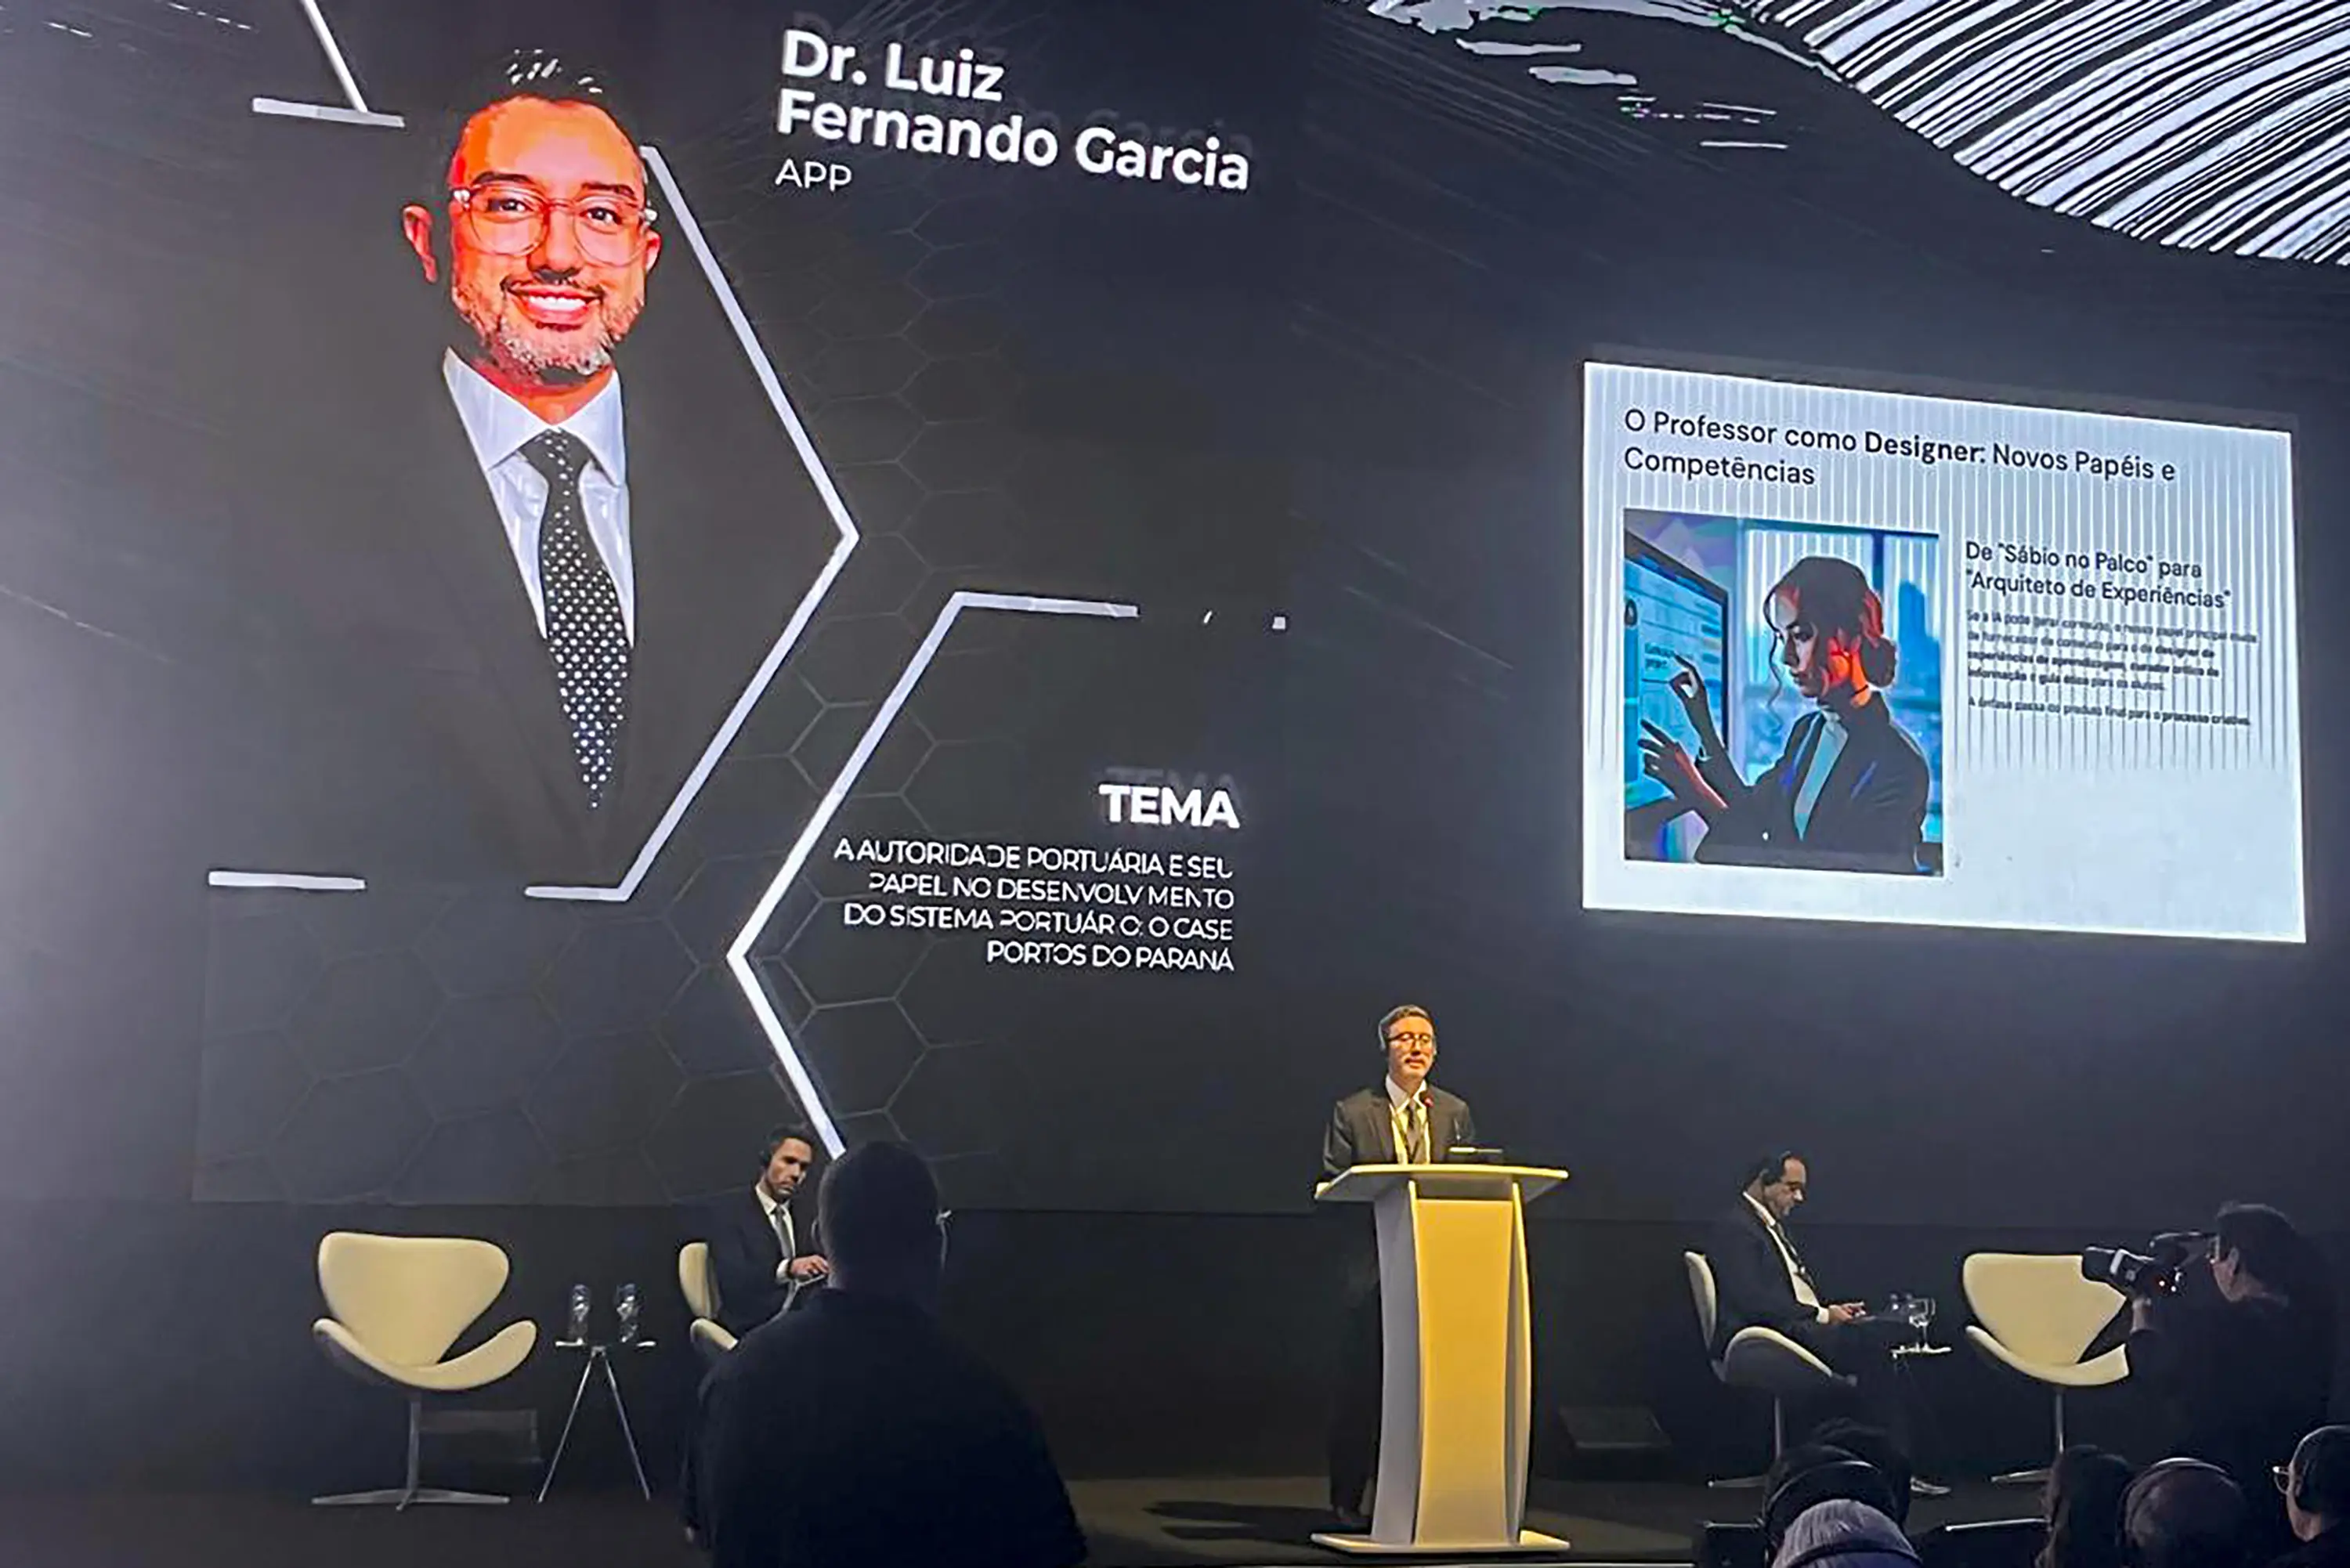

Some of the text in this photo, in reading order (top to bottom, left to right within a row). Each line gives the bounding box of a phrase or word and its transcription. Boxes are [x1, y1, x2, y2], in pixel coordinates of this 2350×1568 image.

[782, 30, 1005, 102] Dr. Luiz
[777, 88, 1249, 190] Fernando Garcia
[776, 158, 851, 191] APP
[1625, 409, 2176, 481] O Professor como Designer: Novos Papéis e
[1624, 447, 1815, 486] Competências
[1965, 541, 1993, 561] De
[2066, 554, 2090, 569] no
[2159, 562, 2202, 580] para
[2070, 580, 2095, 598] de
[1098, 783, 1240, 829] TEMA
[833, 838, 855, 861] A
[857, 839, 1020, 869] AUTORIDADE
[1028, 847, 1165, 876] PORTUÁRIA
[1170, 854, 1183, 876] E
[868, 873, 1235, 909] PAPEL NO DESENVOLVMENTO
[844, 902, 1233, 941] DO SISTEMA PORTUÁRO: O CASE
[987, 940, 1235, 971] PORTOS DO PARANÁ
